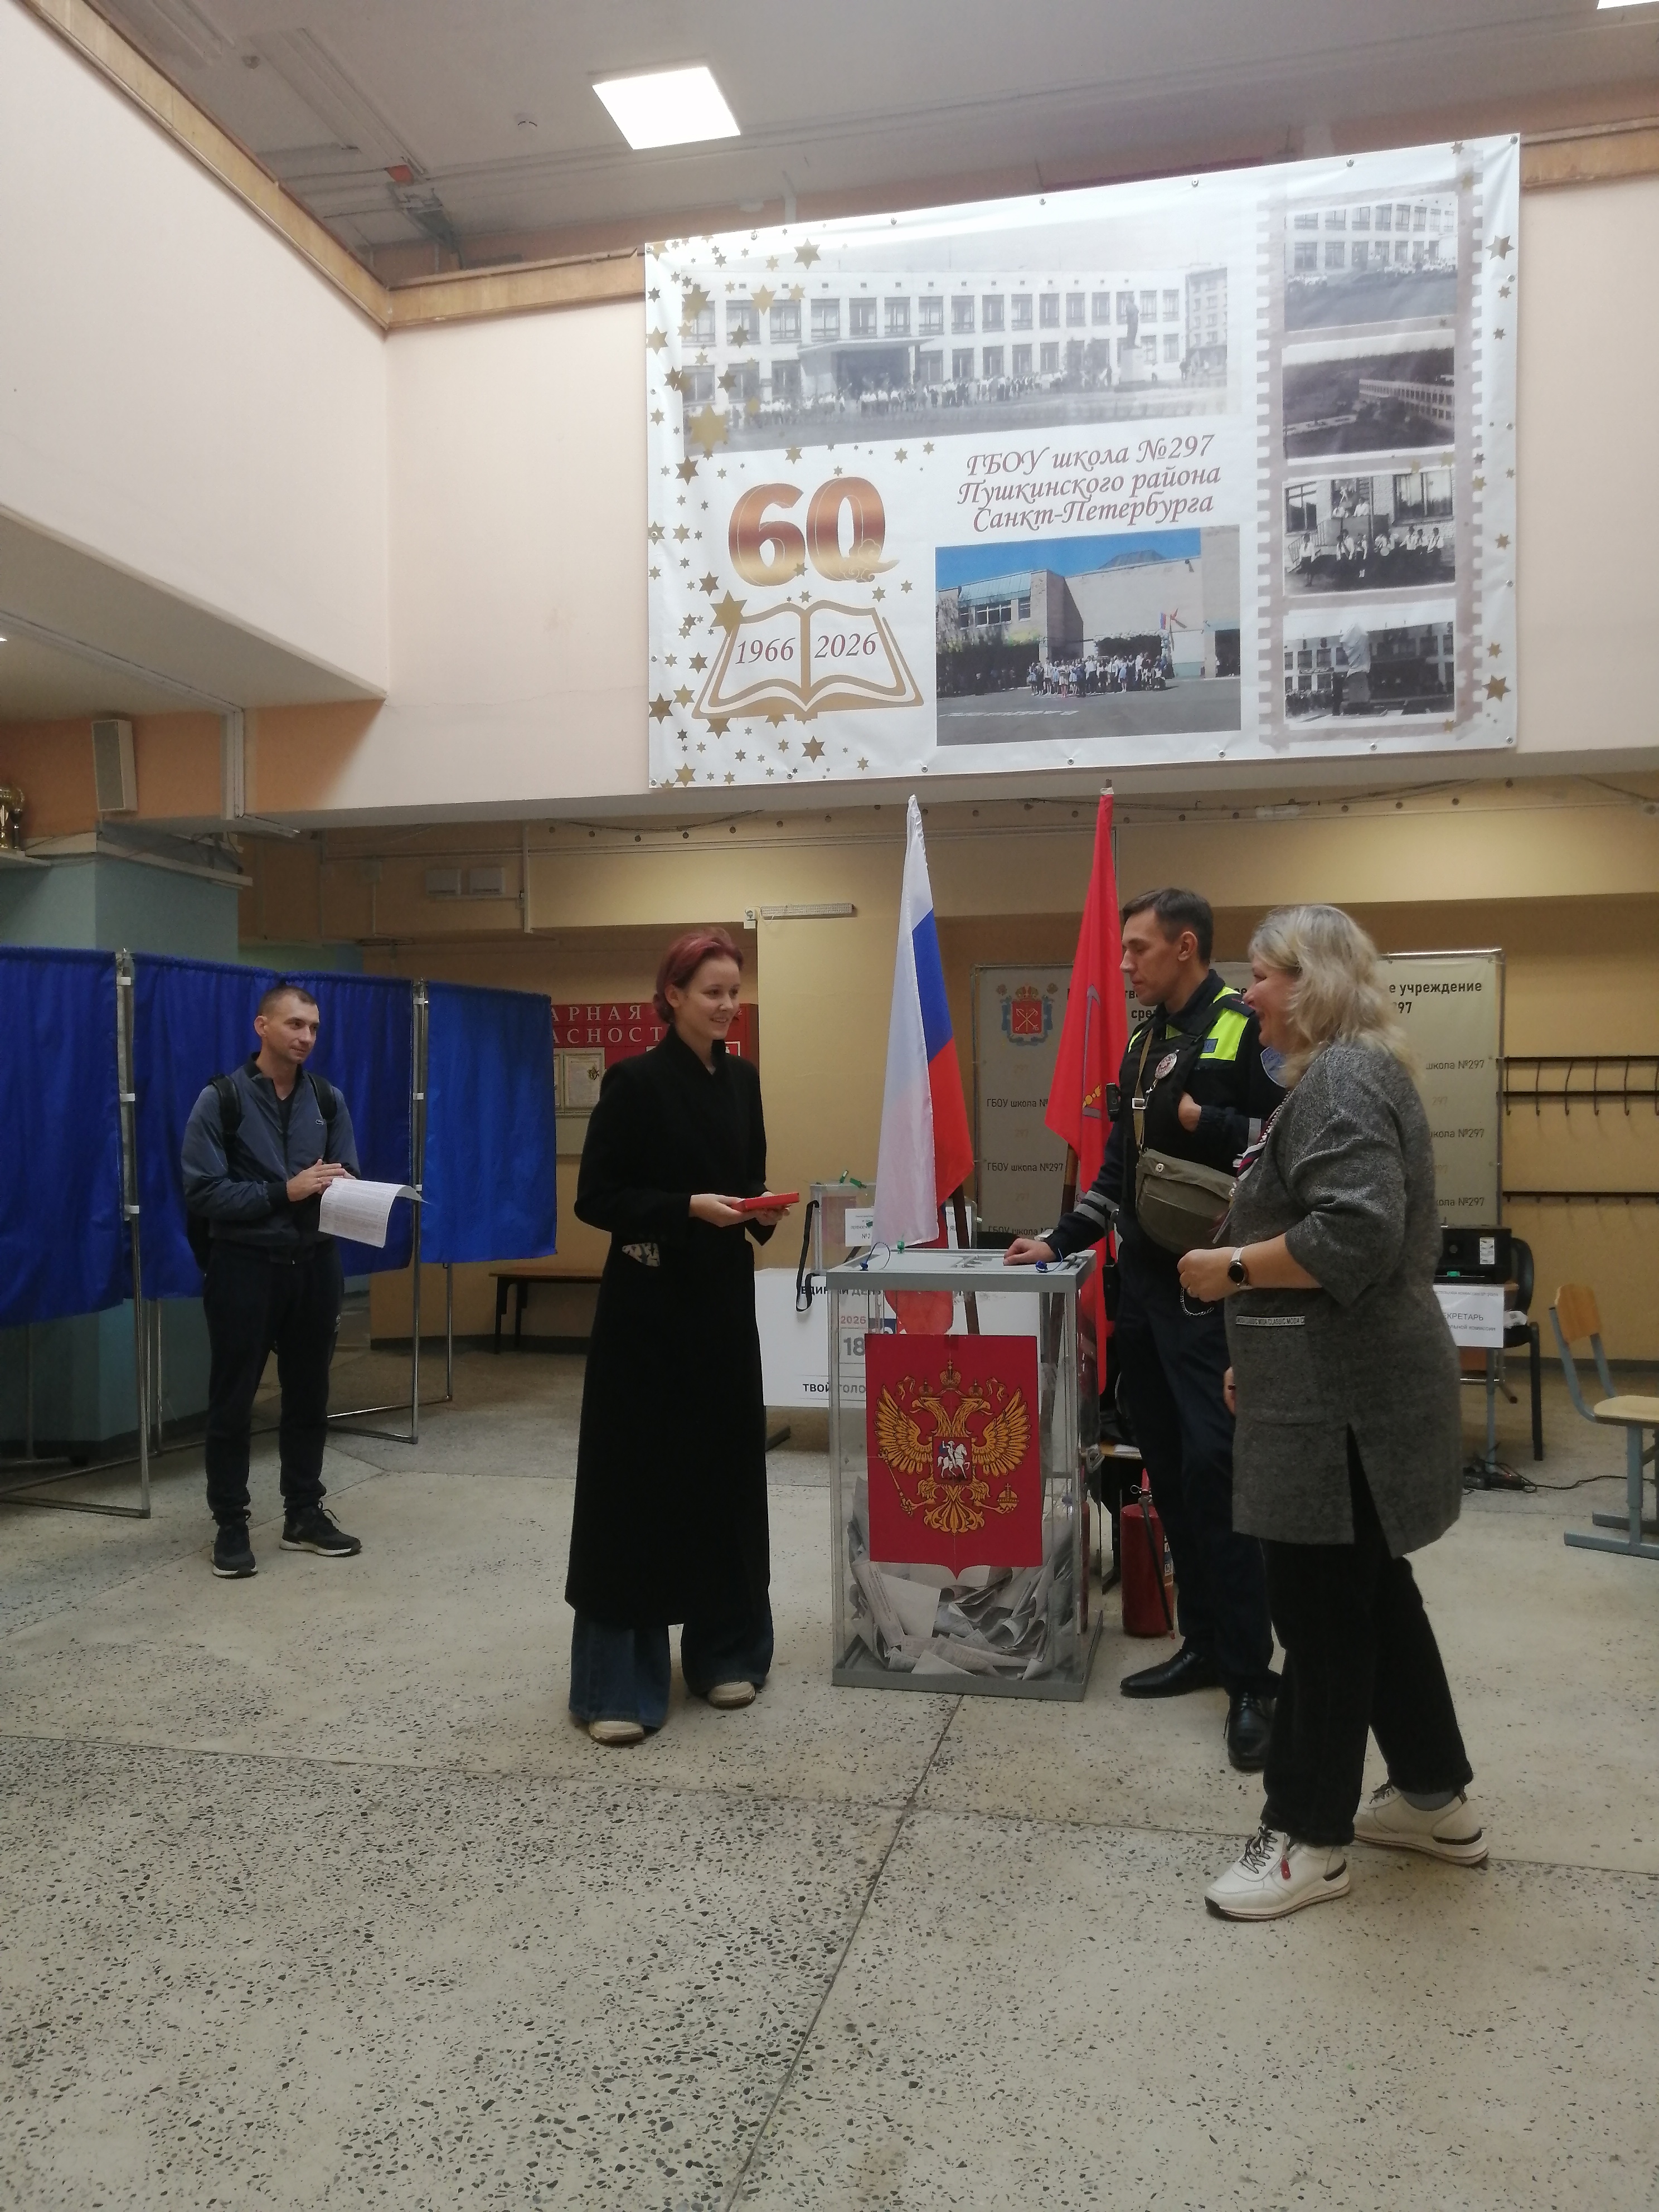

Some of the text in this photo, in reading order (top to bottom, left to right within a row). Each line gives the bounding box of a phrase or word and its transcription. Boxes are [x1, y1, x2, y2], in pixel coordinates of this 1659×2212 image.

[967, 434, 1215, 476] ГБОУ школа №297
[957, 466, 1221, 509] Пушкинского района
[973, 492, 1214, 532] Санкт-Петербурга
[728, 477, 887, 587] 60
[735, 637, 796, 664] 1966
[814, 632, 878, 659] 2026
[1399, 982, 1482, 996] учреждение
[551, 1005, 641, 1022] АРНАЯ
[1131, 1010, 1152, 1022] сре
[1458, 1060, 1485, 1069] №297
[987, 1099, 1008, 1107] ГБОУ
[1458, 1129, 1485, 1137] №297
[987, 1162, 1008, 1171] ГБОУ
[1039, 1163, 1064, 1172] №297
[1458, 1197, 1485, 1206] №297
[840, 1316, 866, 1325] 2026
